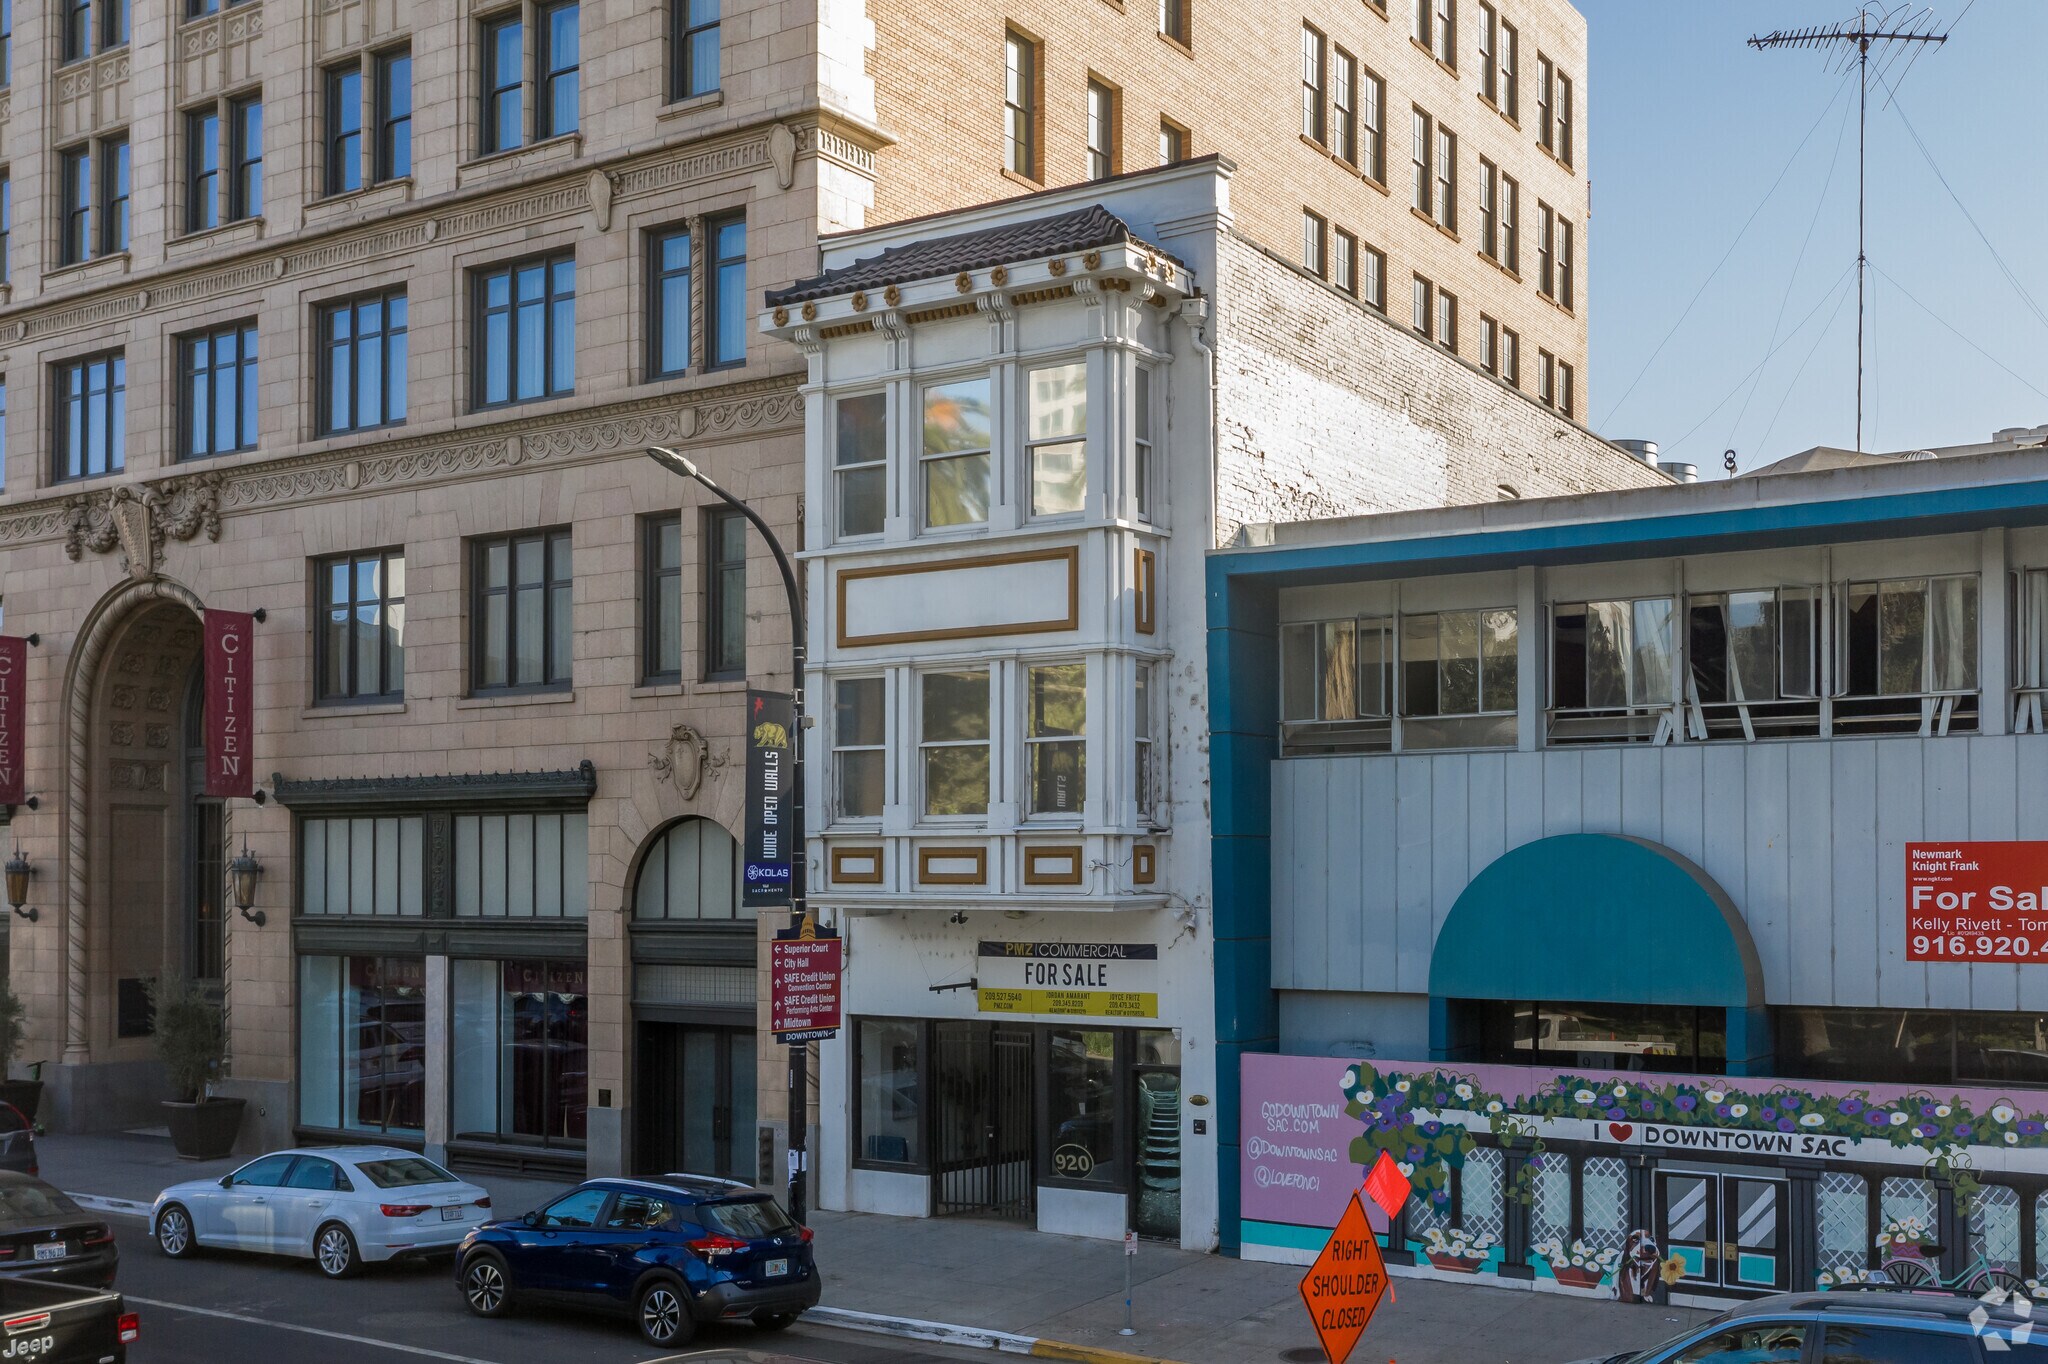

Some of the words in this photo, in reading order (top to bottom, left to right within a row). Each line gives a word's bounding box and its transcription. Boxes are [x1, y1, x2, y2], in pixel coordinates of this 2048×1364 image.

[221, 634, 240, 776] CITIZEN
[765, 751, 778, 791] WALLS
[764, 796, 778, 825] OPEN
[763, 830, 777, 859] WIDE
[1912, 850, 1962, 859] Newmark
[758, 868, 788, 877] KOLAS
[1912, 861, 1947, 873] Knight
[1950, 861, 1979, 871] Frank
[1912, 886, 1977, 910] For
[1912, 917, 1950, 933] Kelly
[1956, 917, 2001, 931] Rivett
[784, 944, 810, 956] Superior
[811, 943, 829, 953] Court
[1005, 943, 1033, 956] PMZ
[1038, 944, 1127, 958] COMMERCIAL
[366, 964, 420, 978] CIIZEN
[784, 959, 796, 970] City
[797, 958, 809, 968] Hall
[523, 969, 584, 984] CIIZEN
[784, 973, 799, 984] SAFE
[800, 972, 818, 983] Credit
[819, 971, 836, 981] Union
[1025, 962, 1058, 986] FOR
[1062, 963, 1107, 987] SALE
[788, 984, 815, 992] Convention
[815, 982, 832, 990] Center
[784, 995, 799, 1006] SAFE
[800, 995, 818, 1005] Credit
[819, 994, 836, 1003] Union
[786, 1006, 809, 1016] Performing
[809, 1005, 819, 1013] Arts
[818, 1004, 833, 1012] Center
[783, 1018, 811, 1028] Midtown
[786, 1030, 829, 1041] DOWNTOWN
[1267, 1118, 1320, 1134] SAC.COM
[1594, 1123, 1599, 1140] I
[1645, 1126, 1792, 1153] DOWNTOWN
[1801, 1136, 1846, 1157] SAC
[1055, 1153, 1090, 1172] 920
[1332, 1239, 1370, 1262] RIGHT
[1312, 1273, 1379, 1297] SHOULDER
[1321, 1307, 1366, 1330] CLOSED
[2, 1335, 54, 1358] Jeep
